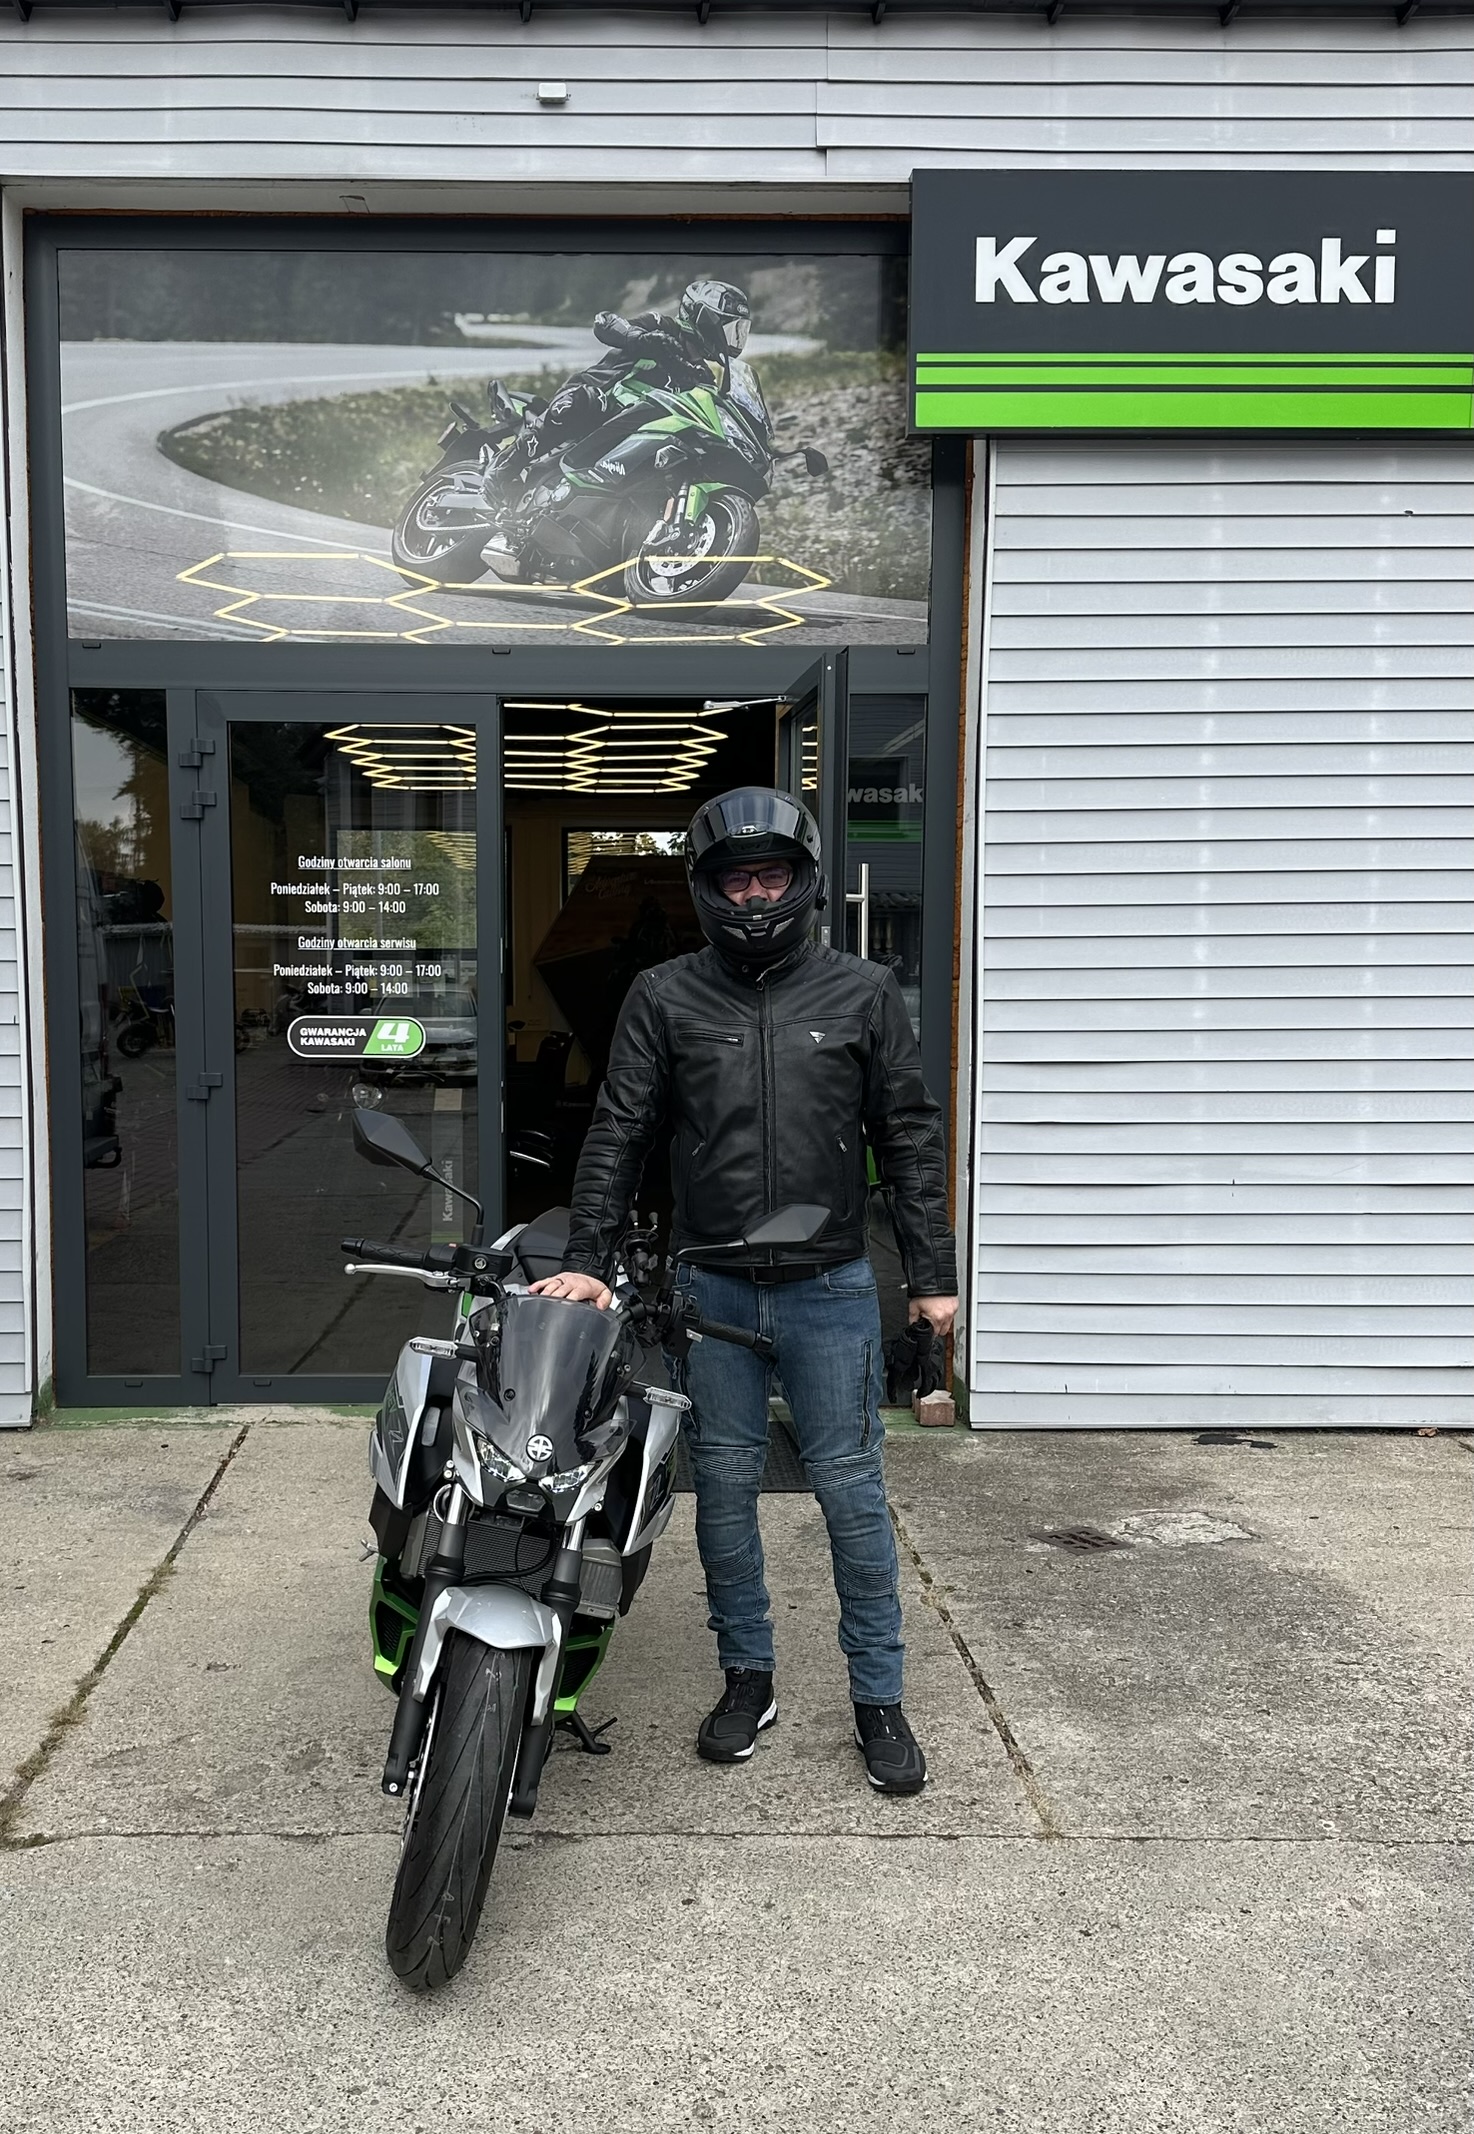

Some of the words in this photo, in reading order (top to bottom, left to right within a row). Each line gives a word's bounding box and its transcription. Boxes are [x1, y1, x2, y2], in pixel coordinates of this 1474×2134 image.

[975, 228, 1397, 305] Kawasaki
[298, 855, 335, 869] Godziny
[337, 857, 378, 869] otwarcia
[380, 856, 412, 869] salonu
[270, 882, 330, 895] Poniedziałek
[342, 882, 376, 898] Piątek:
[377, 883, 401, 895] 9:00
[413, 883, 439, 895] 17:00
[304, 900, 341, 913] Sobota:
[342, 901, 366, 913] 9:00
[378, 901, 406, 913] 14:00
[298, 935, 335, 950] Godziny
[337, 937, 378, 949] otwarcia
[380, 936, 416, 949] serwisu
[273, 963, 333, 976] Poniedziałek
[345, 964, 378, 979] Piątek:
[380, 964, 403, 976] 9:00
[415, 964, 441, 976] 17:00
[307, 982, 343, 994] Sobota:
[344, 982, 368, 994] 9:00
[381, 982, 408, 994] 14:00
[300, 1028, 367, 1036] GWARANCJA
[377, 1023, 410, 1043] 4
[300, 1038, 355, 1046] KAWASAKI
[381, 1044, 404, 1052] LATA
